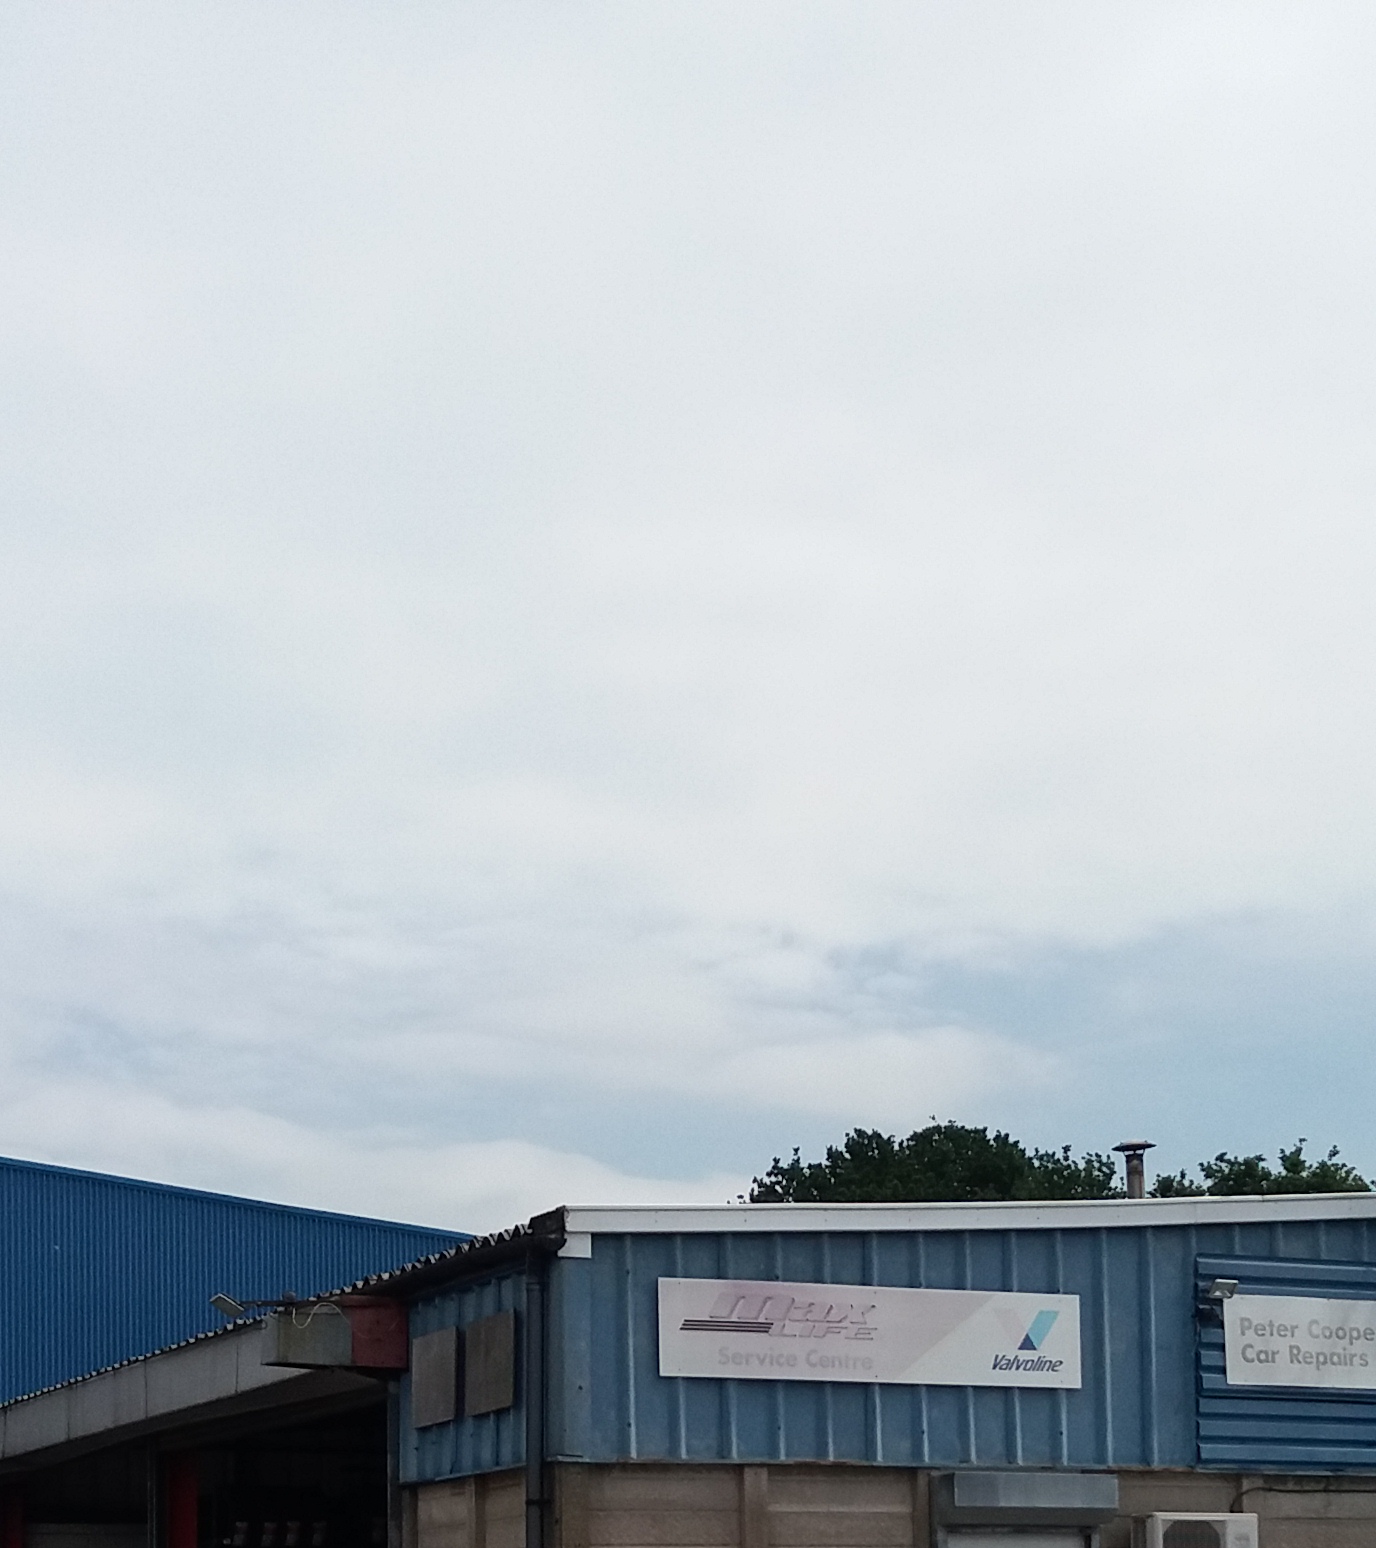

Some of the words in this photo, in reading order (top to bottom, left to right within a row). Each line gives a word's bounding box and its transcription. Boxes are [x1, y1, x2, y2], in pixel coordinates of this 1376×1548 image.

[768, 1323, 878, 1341] LIFE
[1239, 1316, 1299, 1338] Peter
[717, 1346, 798, 1368] Service
[805, 1348, 874, 1370] Centre
[991, 1354, 1064, 1373] Valvoline
[1240, 1343, 1280, 1364] Car
[1288, 1344, 1370, 1371] Repairs
